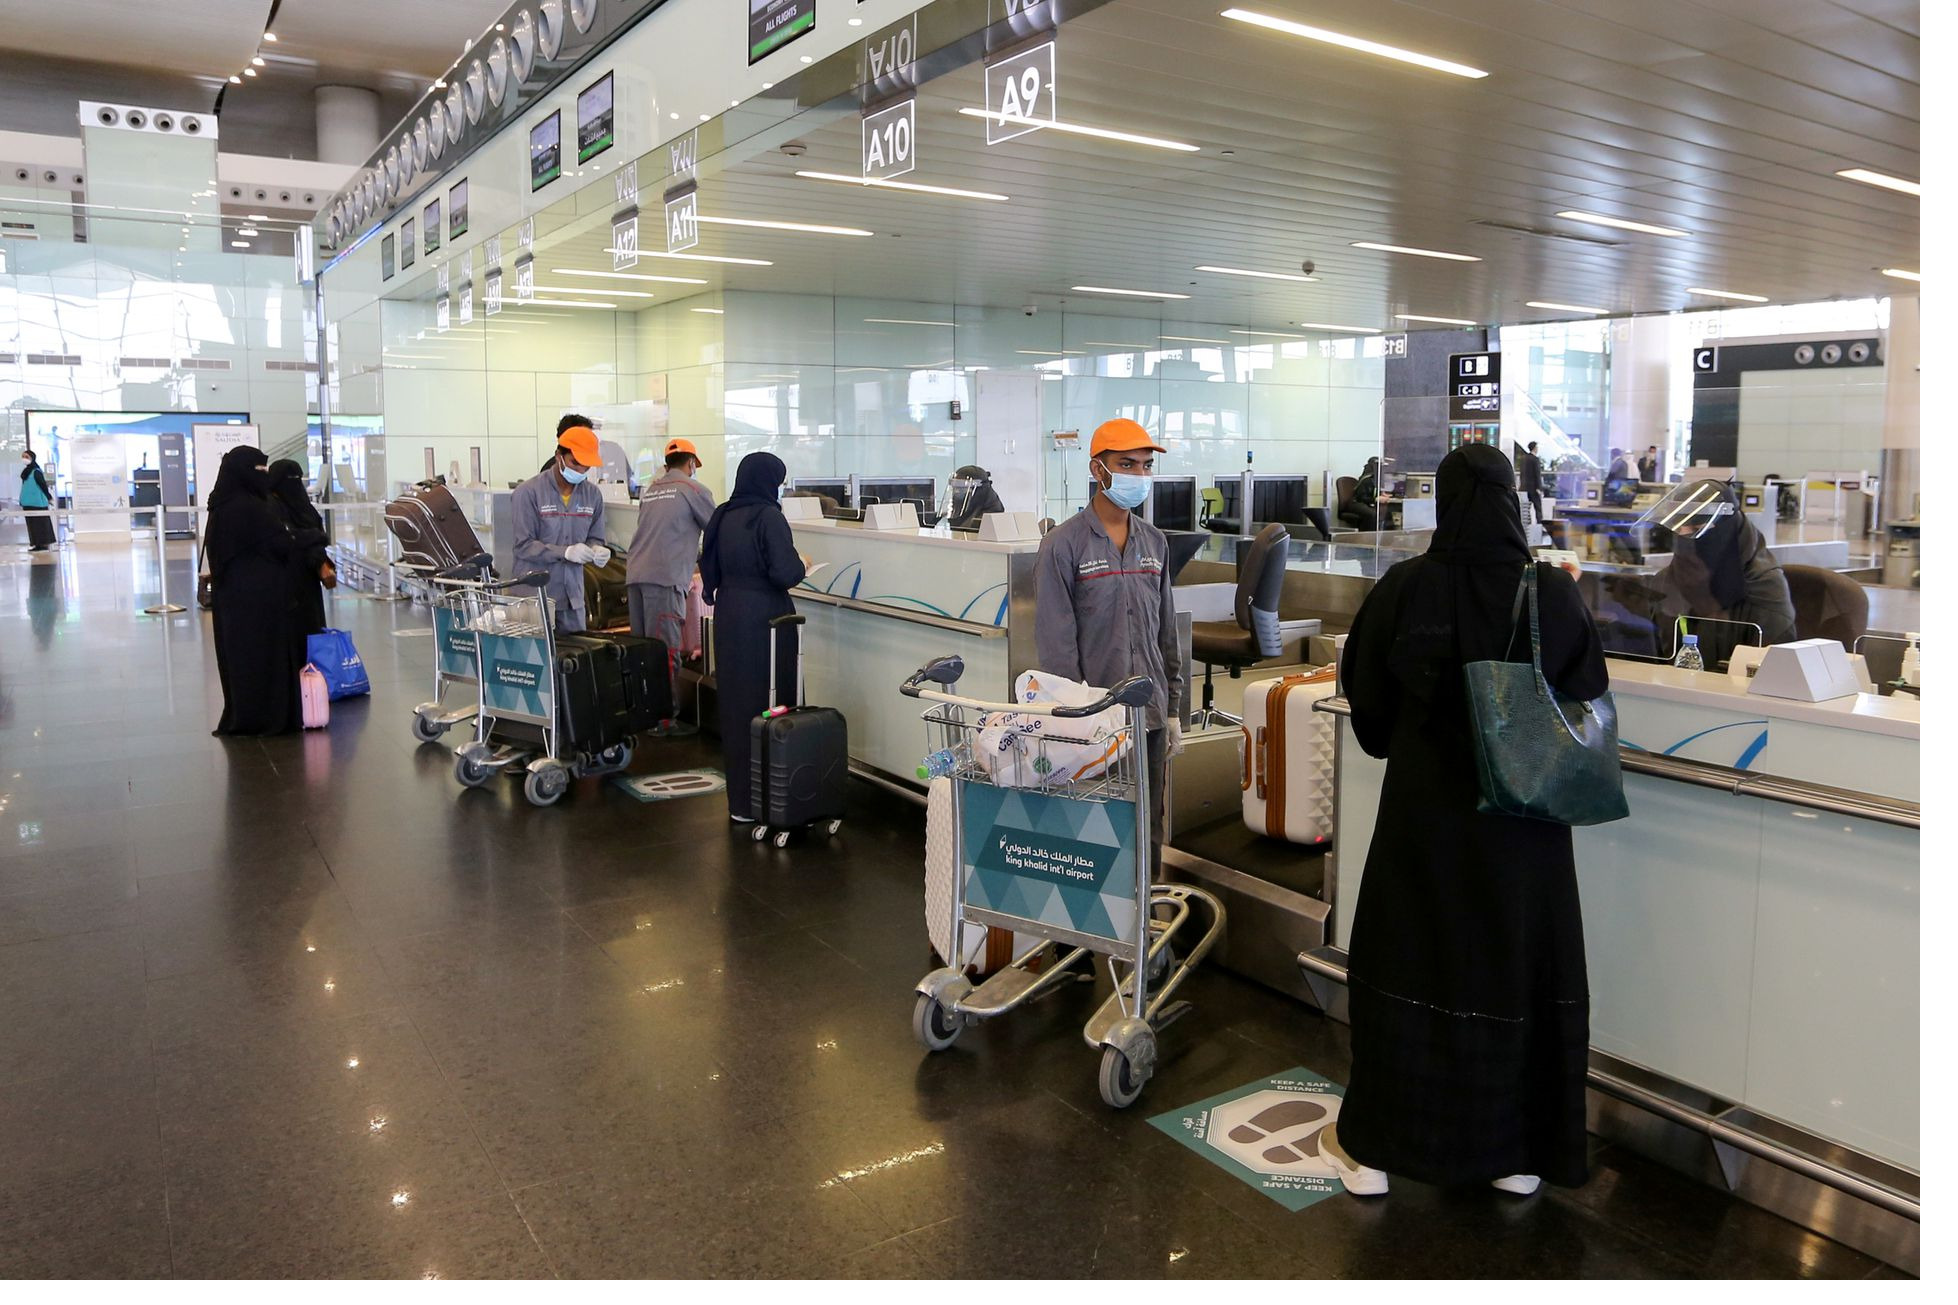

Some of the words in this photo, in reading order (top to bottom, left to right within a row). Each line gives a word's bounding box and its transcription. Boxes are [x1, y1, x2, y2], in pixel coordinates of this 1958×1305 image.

[766, 20, 776, 32] ALL
[776, 4, 798, 26] FLIGHTS
[998, 66, 1041, 127] A9
[866, 117, 910, 172] A10
[672, 205, 692, 243] A11
[616, 228, 635, 263] A12
[1464, 360, 1473, 373] B
[1697, 350, 1711, 369] C
[1001, 711, 1022, 724] Tas
[1005, 843, 1032, 855] الدولي
[1032, 848, 1049, 859] خالد
[1050, 851, 1073, 864] الملك
[1005, 854, 1022, 868] king
[1024, 858, 1048, 871] khalid
[1065, 867, 1094, 880] airport
[1073, 856, 1094, 868] مطار
[1195, 1110, 1208, 1127] مسافة
[1271, 1175, 1325, 1184] DISTANCE
